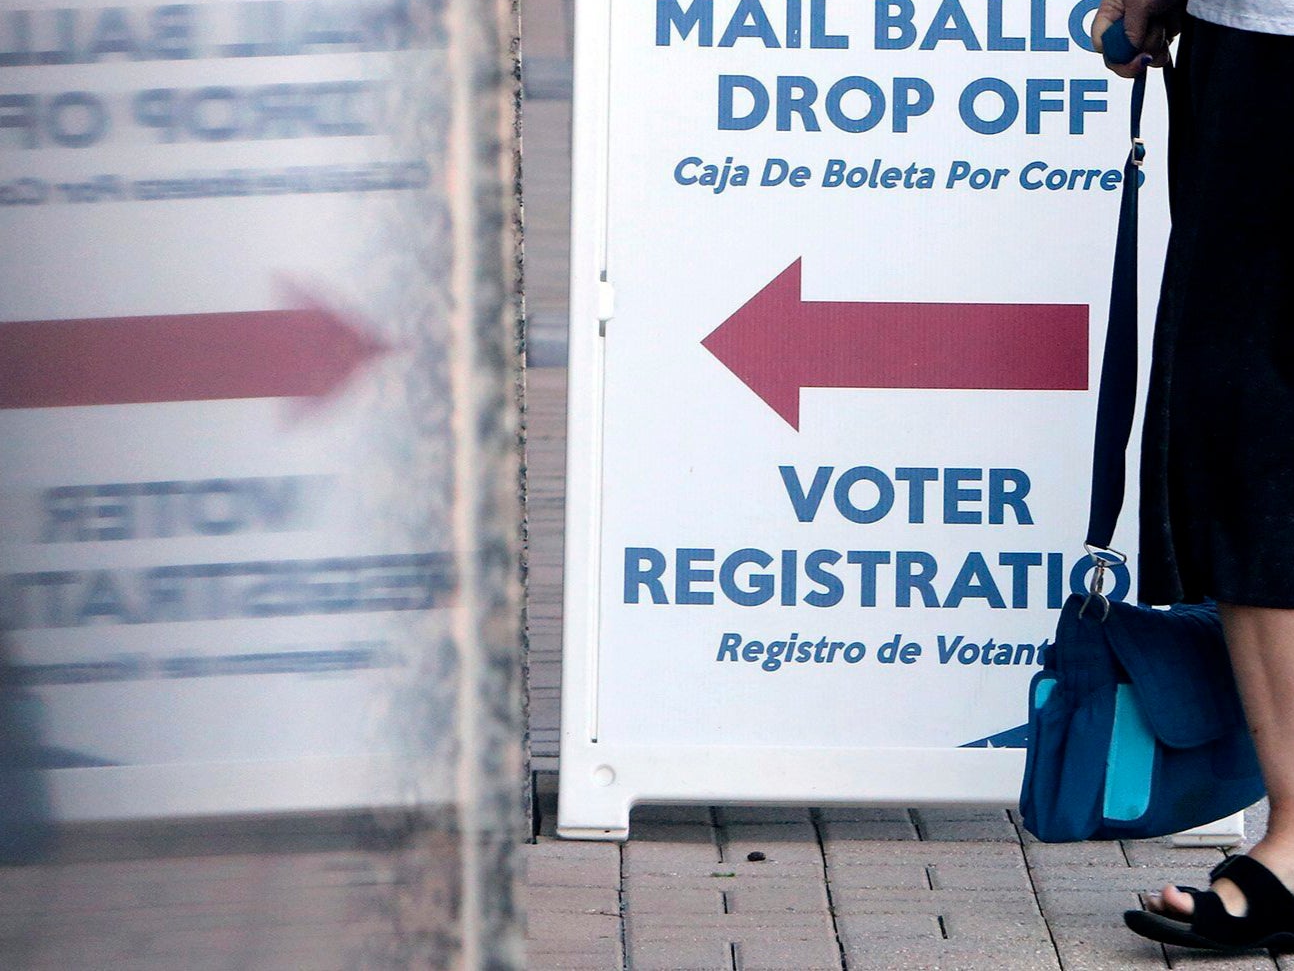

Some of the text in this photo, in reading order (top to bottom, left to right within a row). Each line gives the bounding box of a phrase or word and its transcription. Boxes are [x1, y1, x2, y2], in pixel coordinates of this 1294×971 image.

[717, 74, 1109, 136] DROP OFF
[673, 156, 750, 195] Caja
[760, 157, 812, 187] De
[821, 158, 936, 190] Boleta
[945, 160, 1010, 190] Por
[777, 465, 1035, 526] VOTER
[623, 546, 1148, 610] REGISTRATIO
[716, 632, 1051, 673] Registro de Votant
